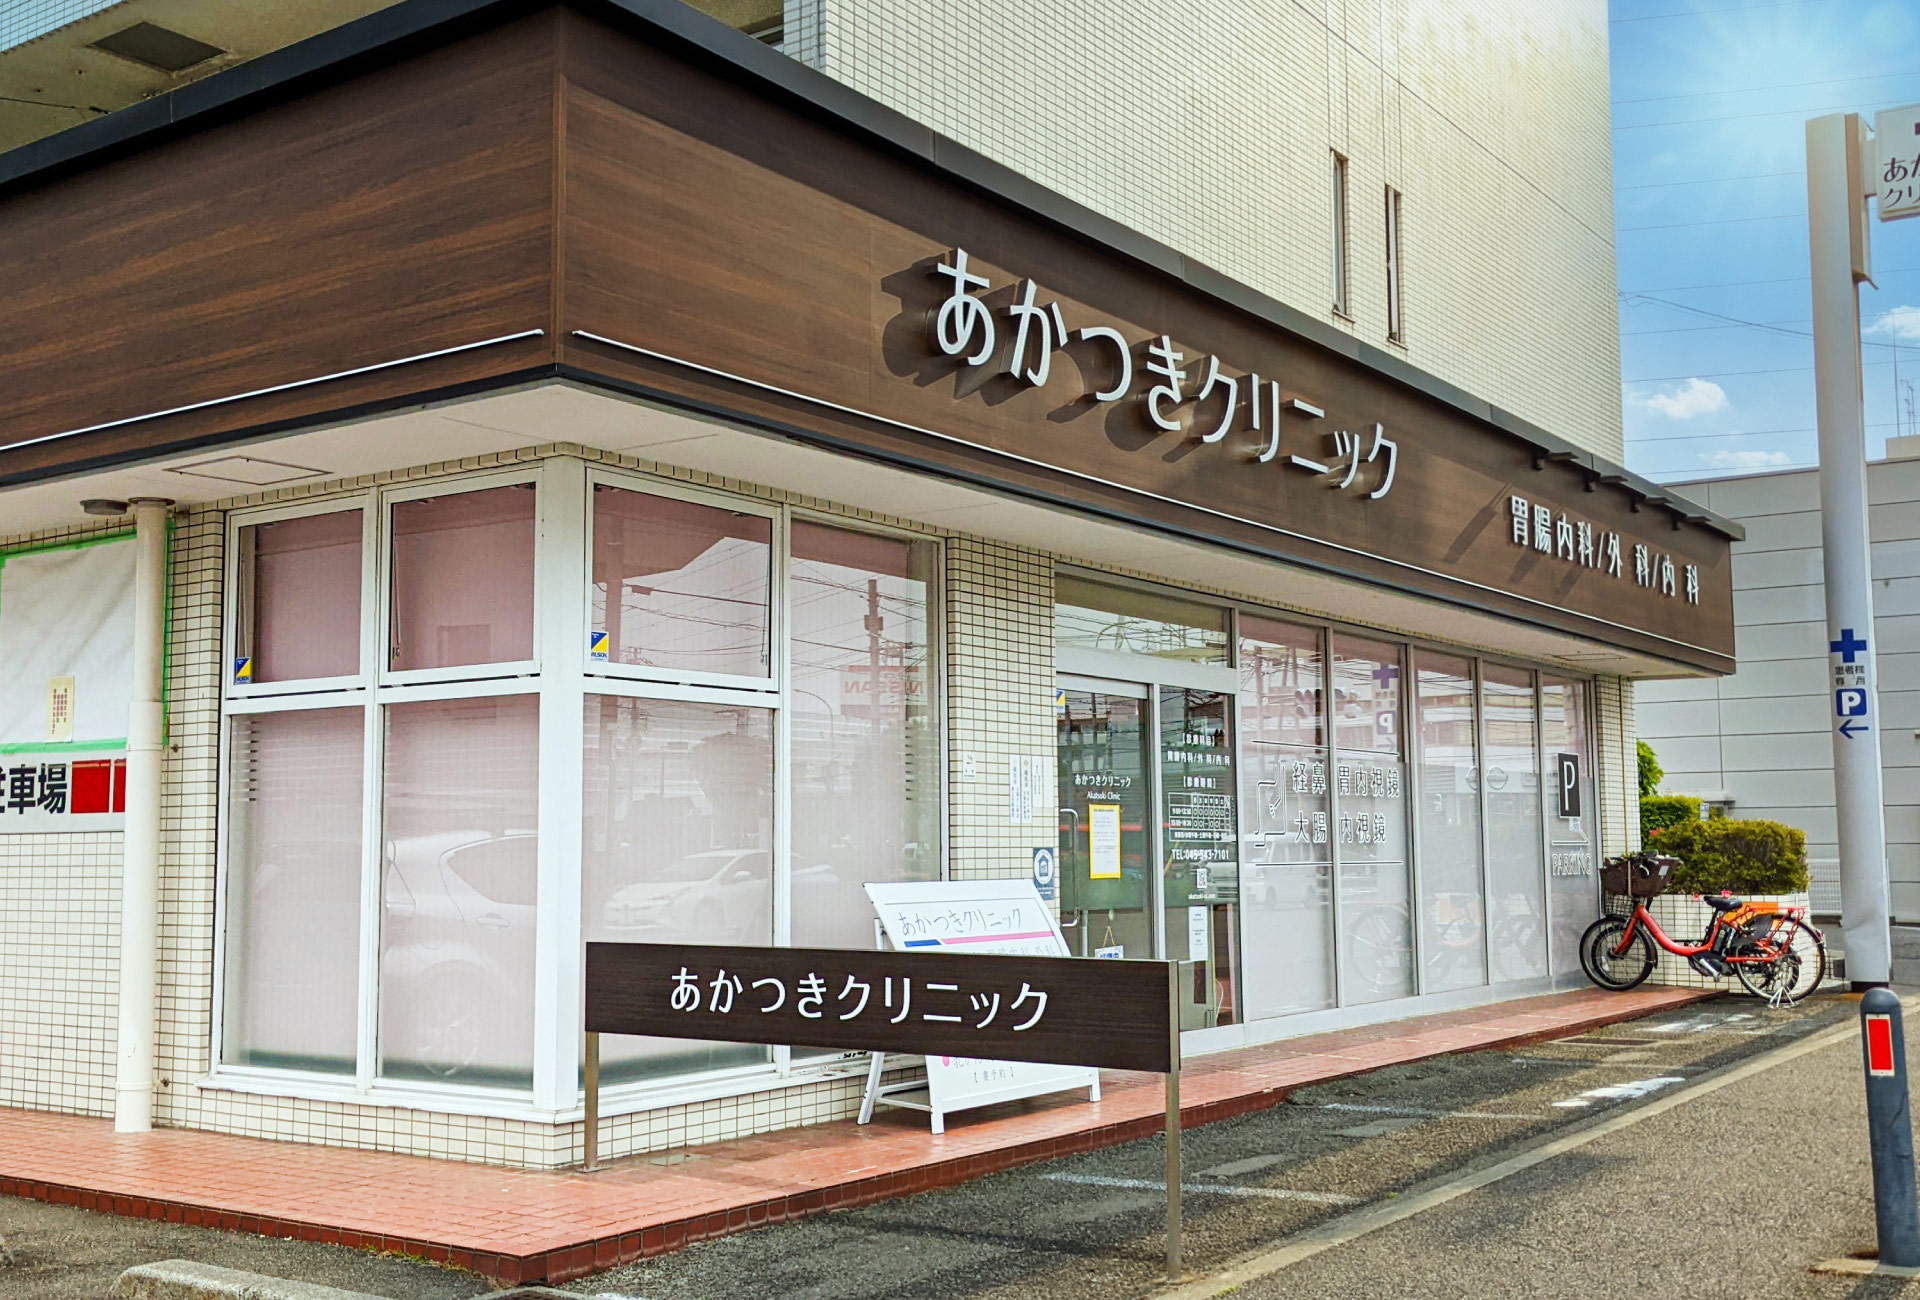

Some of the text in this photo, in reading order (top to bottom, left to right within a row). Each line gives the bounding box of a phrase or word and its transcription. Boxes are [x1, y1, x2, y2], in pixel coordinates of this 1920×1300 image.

[936, 246, 1398, 500] あかつきクリニック
[1841, 691, 1861, 715] P
[1075, 773, 1132, 788] あかつきクリニック
[1107, 791, 1121, 800] Clinic
[1292, 761, 1401, 797] 経鼻胃内視鏡
[1563, 760, 1576, 811] P
[1294, 810, 1386, 843] 大腸内視鏡
[898, 908, 1022, 936] あかつきクリニック
[669, 966, 1049, 1031] あかつきクリニック
